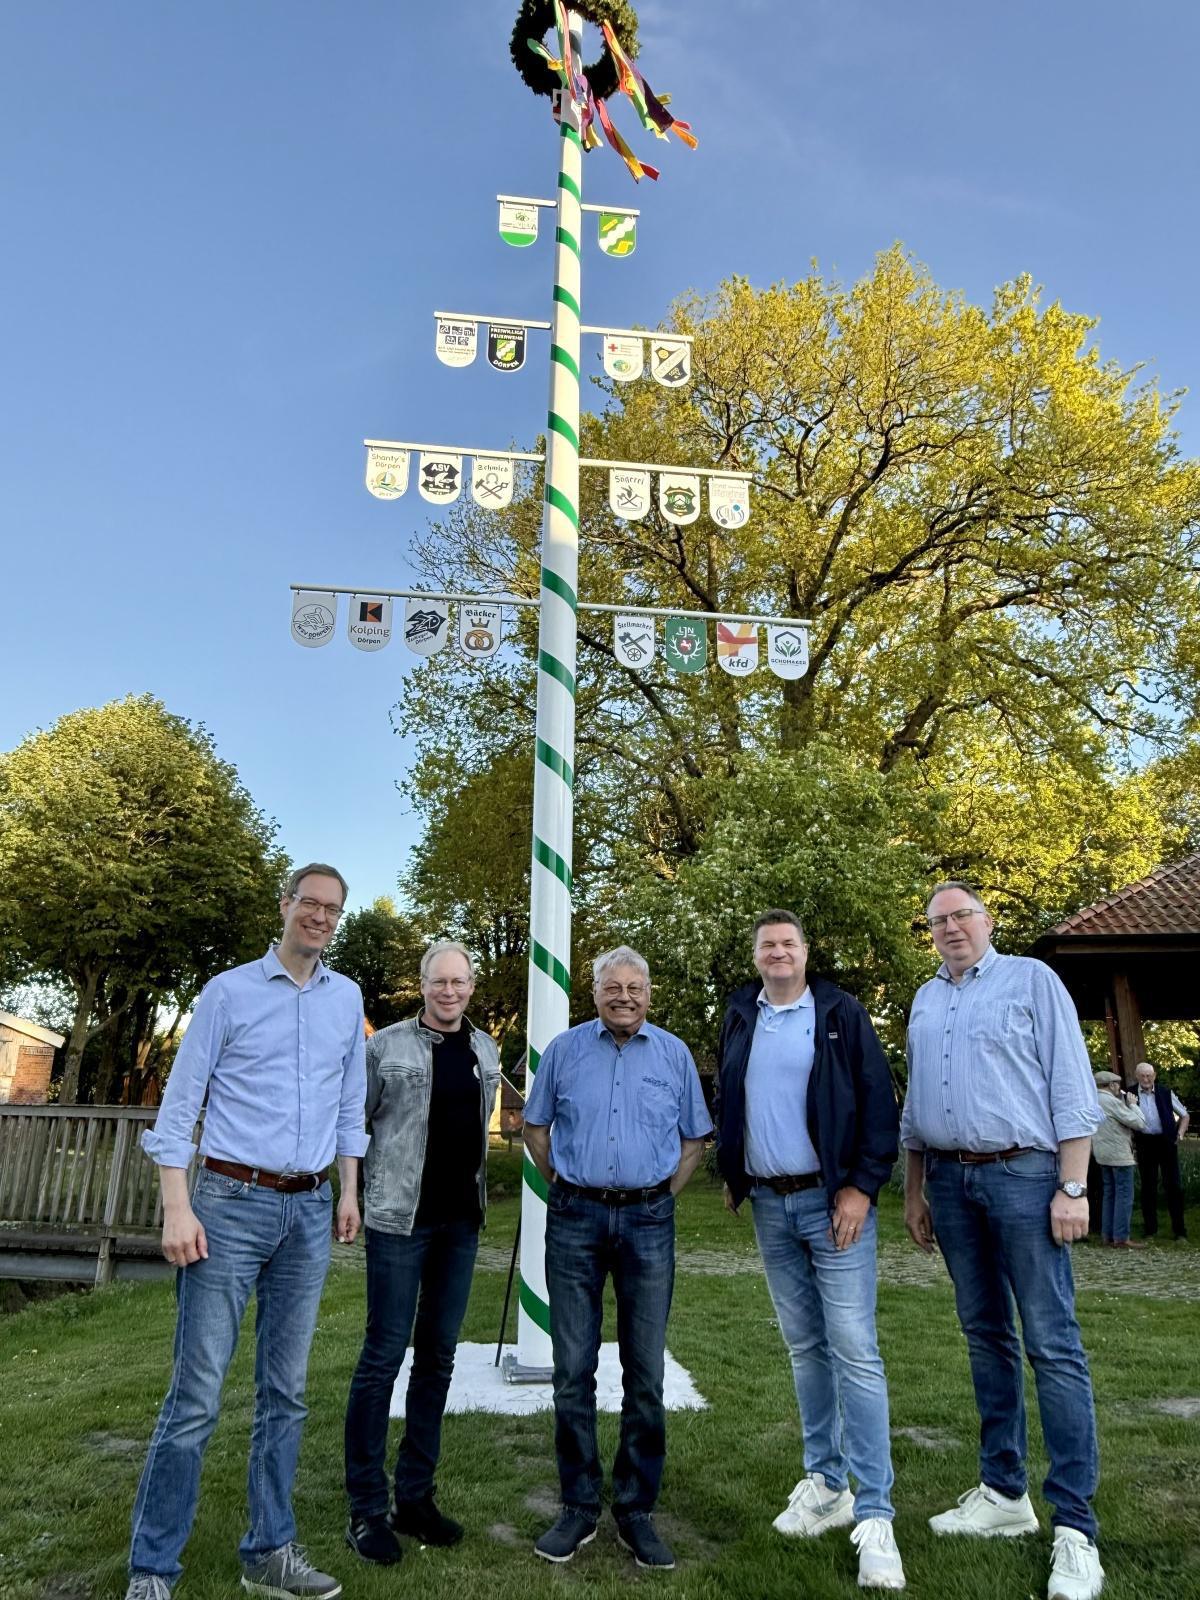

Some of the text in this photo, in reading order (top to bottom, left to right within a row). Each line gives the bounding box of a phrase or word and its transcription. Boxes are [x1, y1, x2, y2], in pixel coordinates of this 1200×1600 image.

[431, 463, 450, 471] ASV
[465, 609, 497, 618] Bäcker
[350, 624, 390, 638] Kolping
[728, 658, 749, 668] kfd
